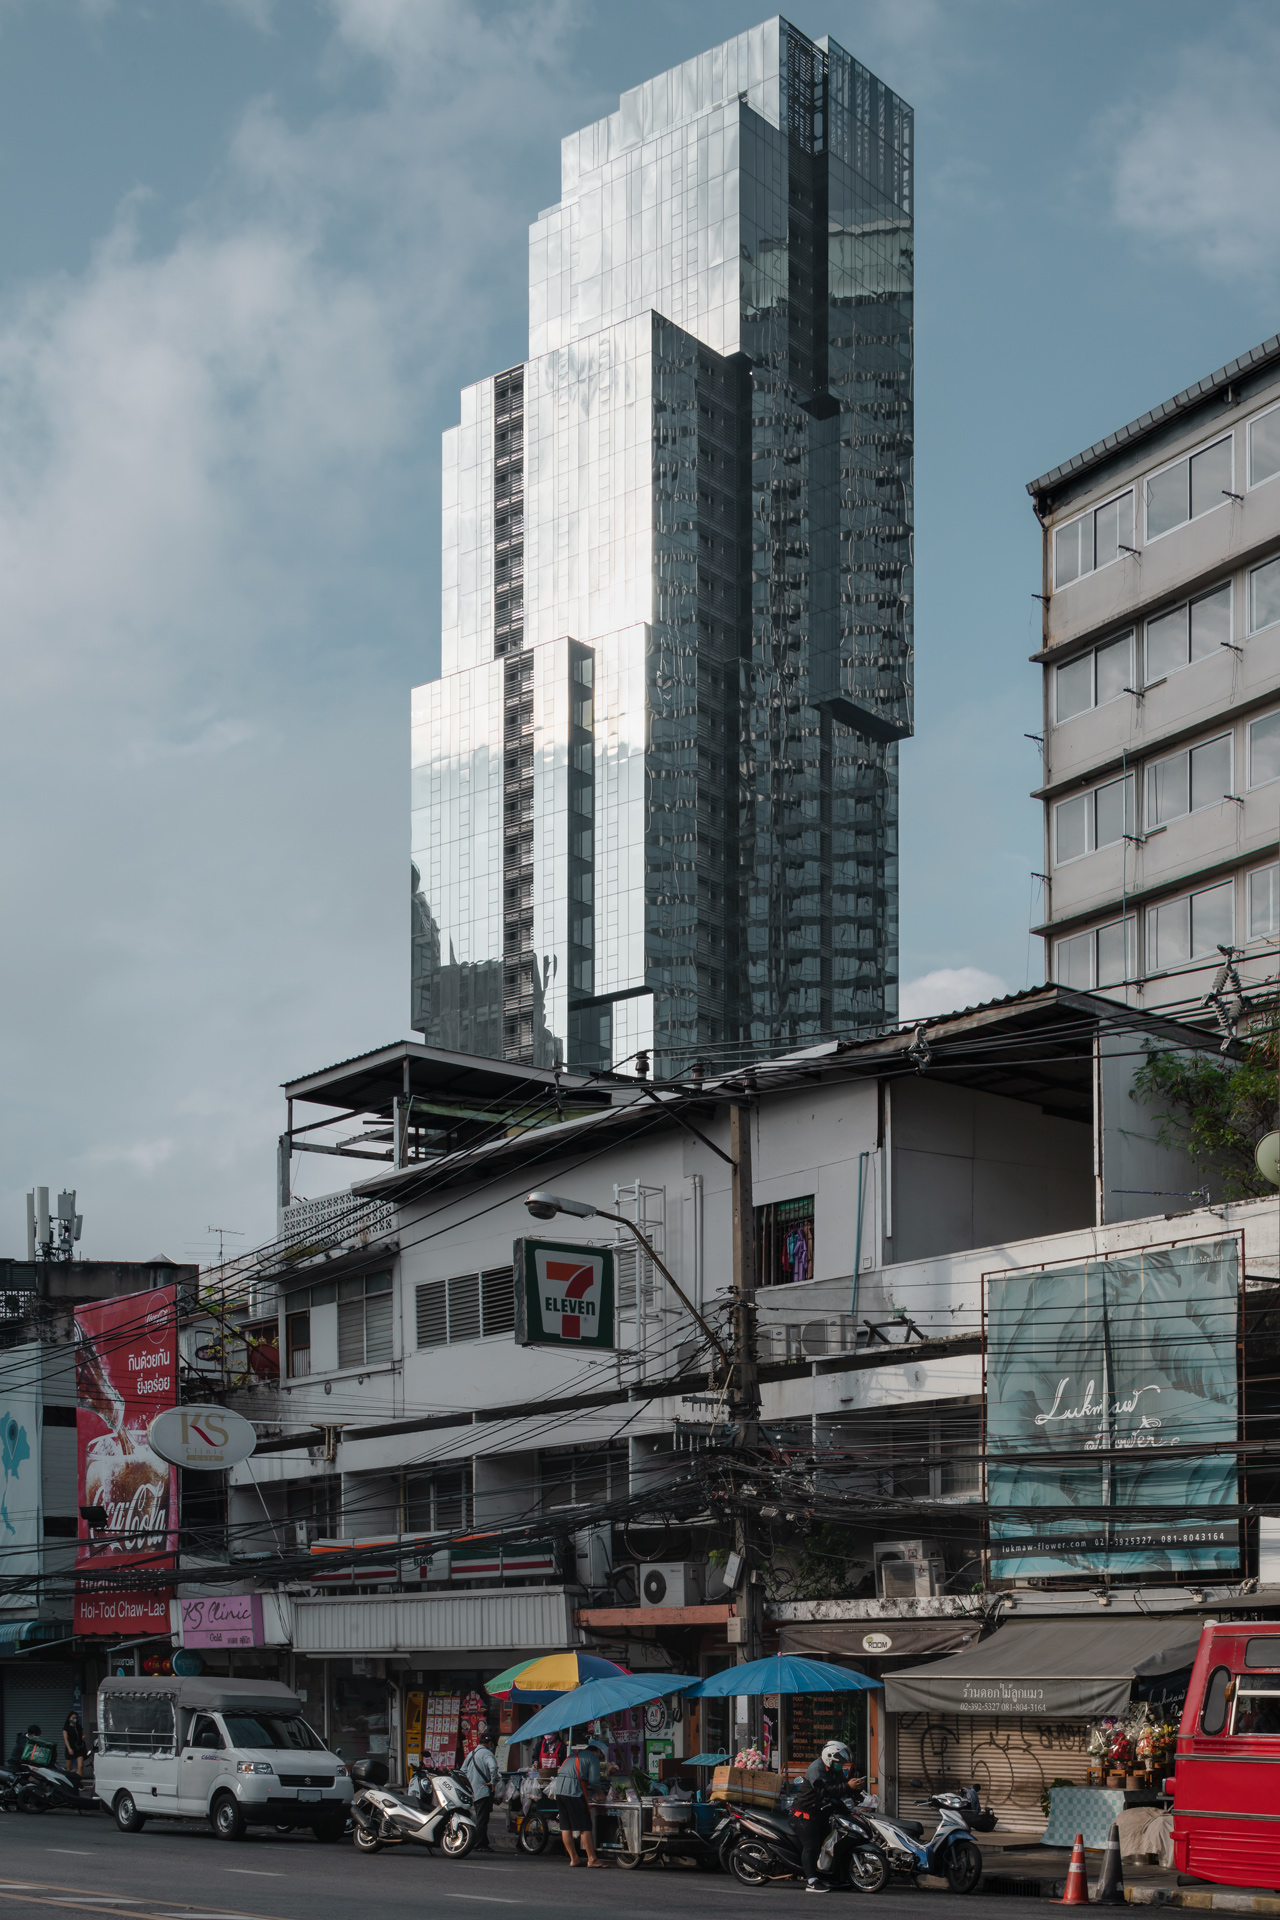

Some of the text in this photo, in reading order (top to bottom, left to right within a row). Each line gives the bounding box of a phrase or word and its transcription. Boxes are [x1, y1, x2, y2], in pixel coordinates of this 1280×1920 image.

[128, 1348, 170, 1371] กินด้วยกัน
[137, 1373, 170, 1395] ยิ่งอร่อย
[180, 1412, 229, 1447] KS
[186, 1447, 224, 1455] Clinic
[1161, 1532, 1225, 1543] 081-8043164
[80, 1600, 166, 1618] Hoi-Tod Chaw-Lae
[208, 1601, 252, 1623] Clinic
[962, 1683, 1044, 1702] ร้านดอกไม้ลูกแมว
[960, 1702, 1046, 1712] 02-392-5327 081-804-3164
